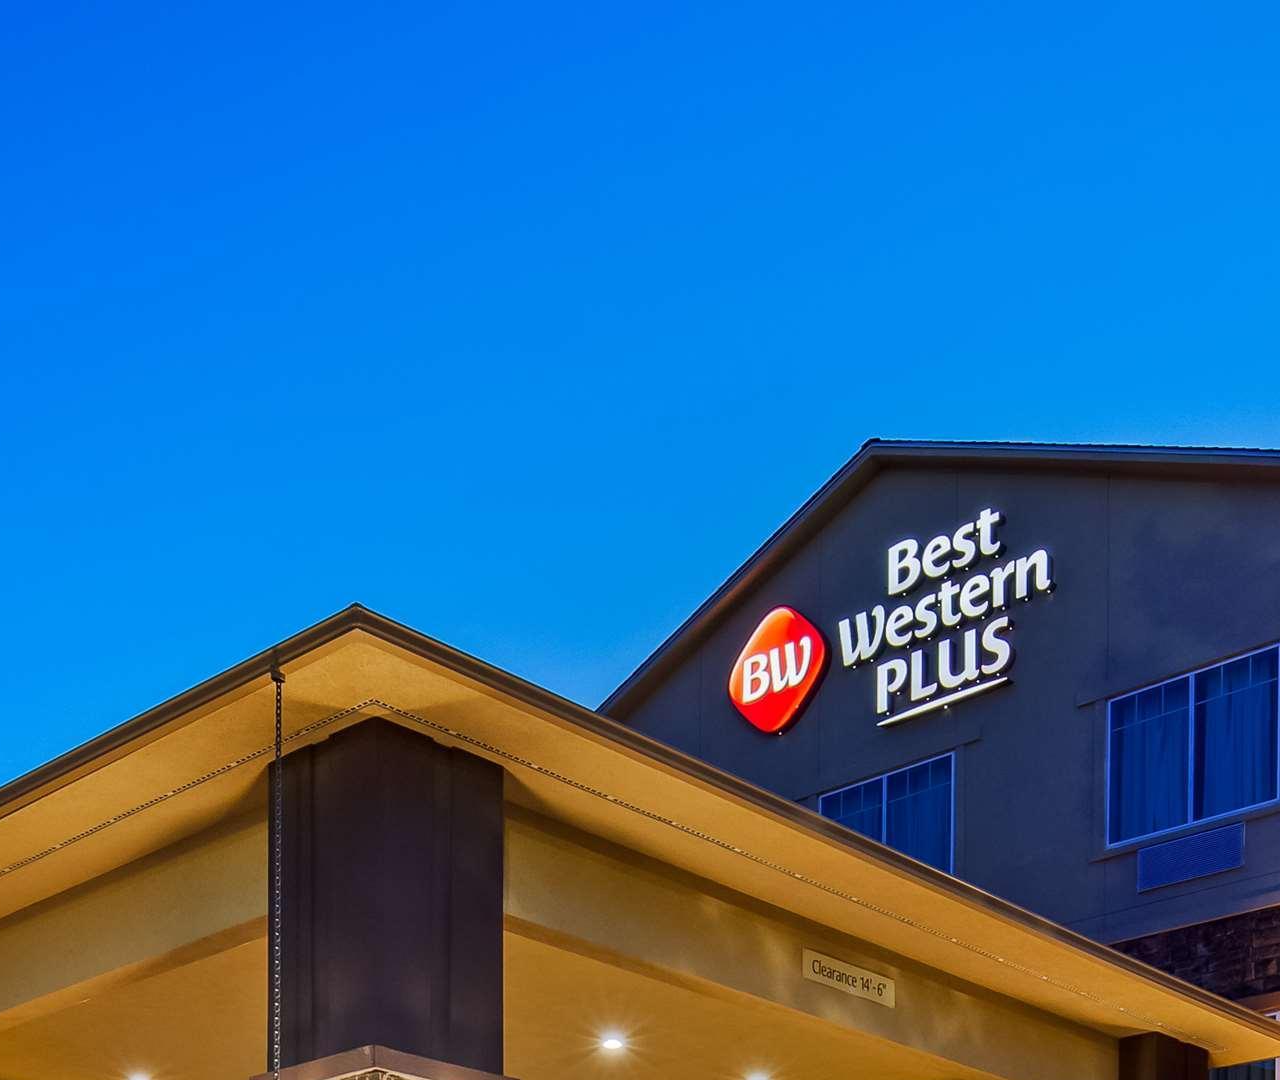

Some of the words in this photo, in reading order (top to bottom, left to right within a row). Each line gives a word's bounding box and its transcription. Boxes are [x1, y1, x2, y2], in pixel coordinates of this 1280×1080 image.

[887, 508, 1001, 596] Best
[838, 549, 1052, 667] Western
[742, 636, 812, 704] BW
[876, 616, 1011, 714] PLUS
[812, 960, 857, 988] Clearance
